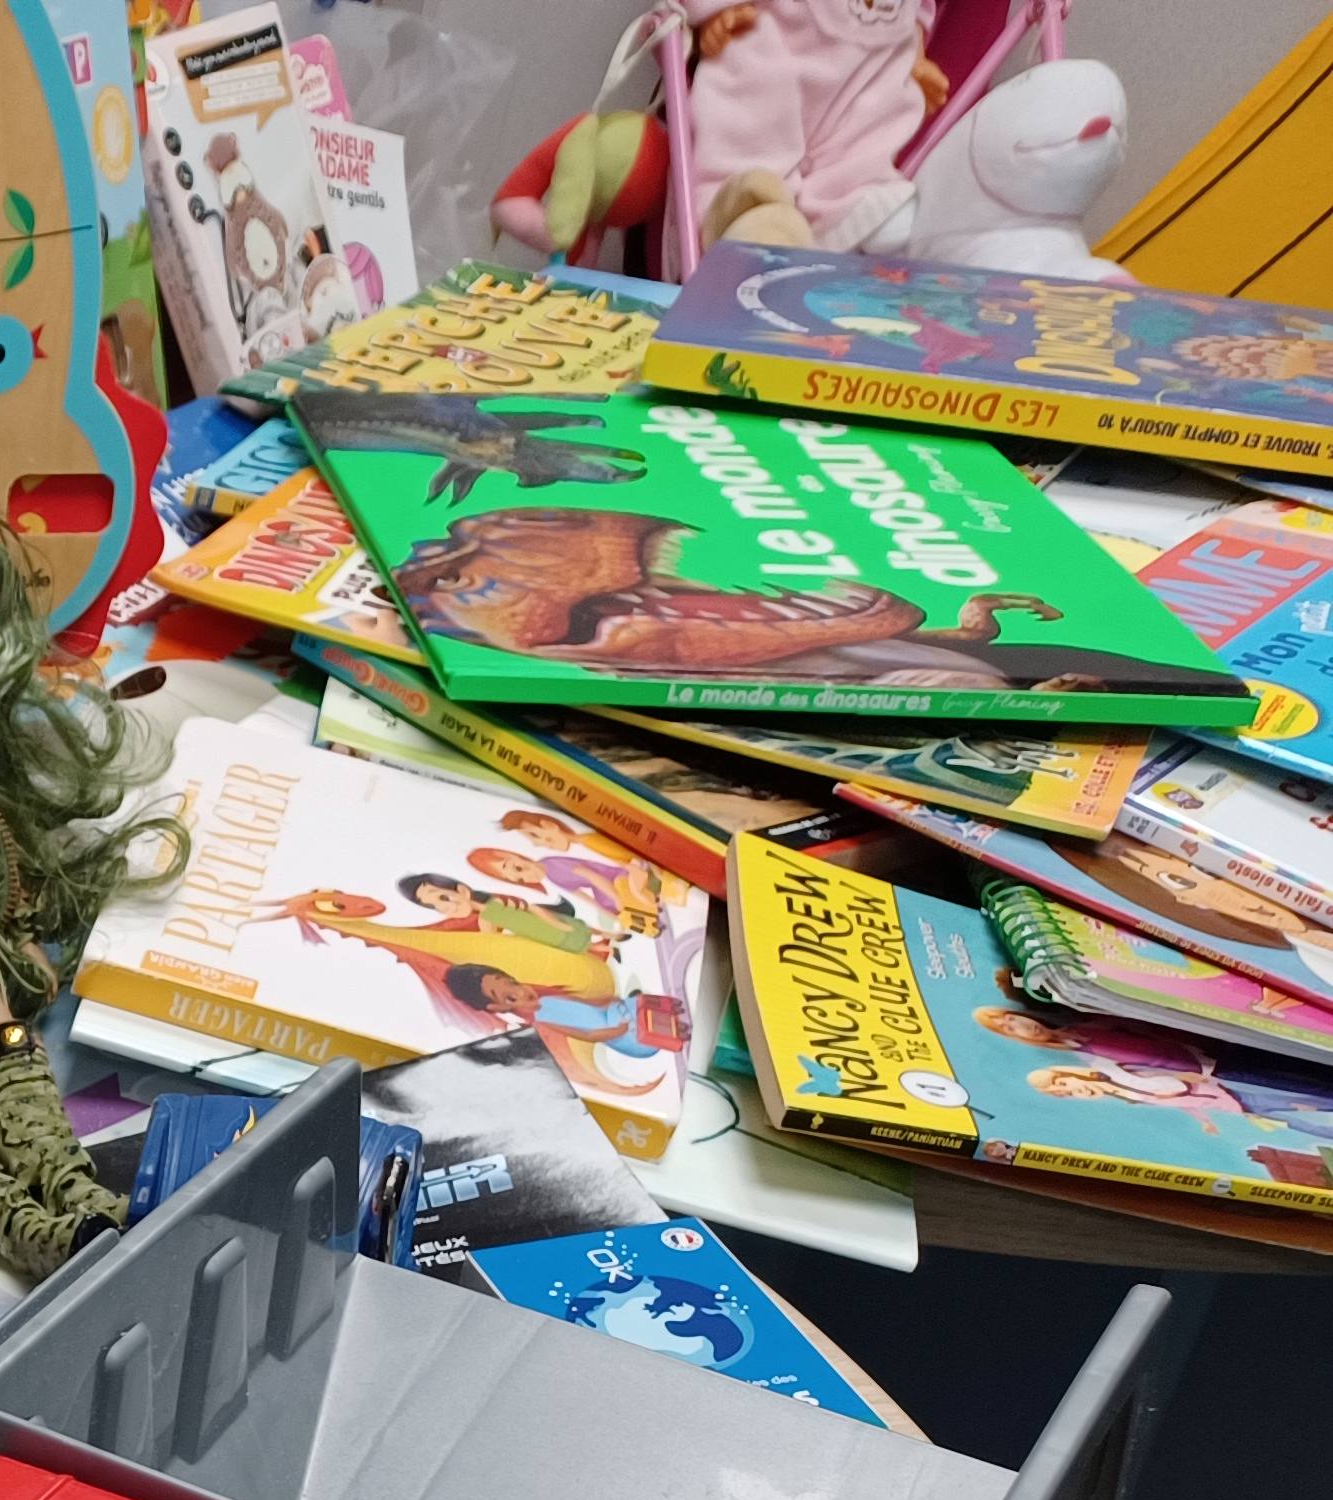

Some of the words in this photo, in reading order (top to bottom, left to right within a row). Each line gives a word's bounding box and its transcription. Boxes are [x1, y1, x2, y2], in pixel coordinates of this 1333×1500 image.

[347, 189, 386, 209] gentils
[803, 368, 1002, 425] DINOSAURES
[1007, 403, 1061, 428] LES
[1097, 411, 1115, 429] 10
[1119, 413, 1180, 440] JUSQU'À
[1181, 422, 1239, 445] COMPTE
[1242, 432, 1259, 448] ET
[1259, 434, 1322, 458] TROUVE
[641, 405, 809, 520] monde
[756, 528, 862, 577] Le
[1231, 632, 1315, 675] Mon
[666, 683, 694, 704] Le
[699, 684, 777, 706] monde
[779, 691, 811, 707] des
[812, 688, 932, 713] dinosaures
[478, 732, 497, 751] LA
[496, 745, 521, 767] SUR
[521, 758, 567, 793] GALOP
[565, 784, 588, 804] AU
[594, 803, 641, 837] BRYANT
[161, 762, 301, 955] PARTAGER
[1226, 857, 1276, 887] sieste
[765, 849, 860, 985] DREW
[838, 879, 906, 970] CREW
[868, 971, 923, 1036] CLUE
[170, 991, 333, 1061] PARTAGER
[1022, 1149, 1059, 1166] NANCY
[1060, 1155, 1092, 1171] DREW
[1093, 1158, 1118, 1174] AND
[1120, 1162, 1142, 1177] THE
[1143, 1166, 1174, 1182] CLUE
[1174, 1171, 1207, 1188] CREW
[1250, 1184, 1315, 1205] SLEEPOVER
